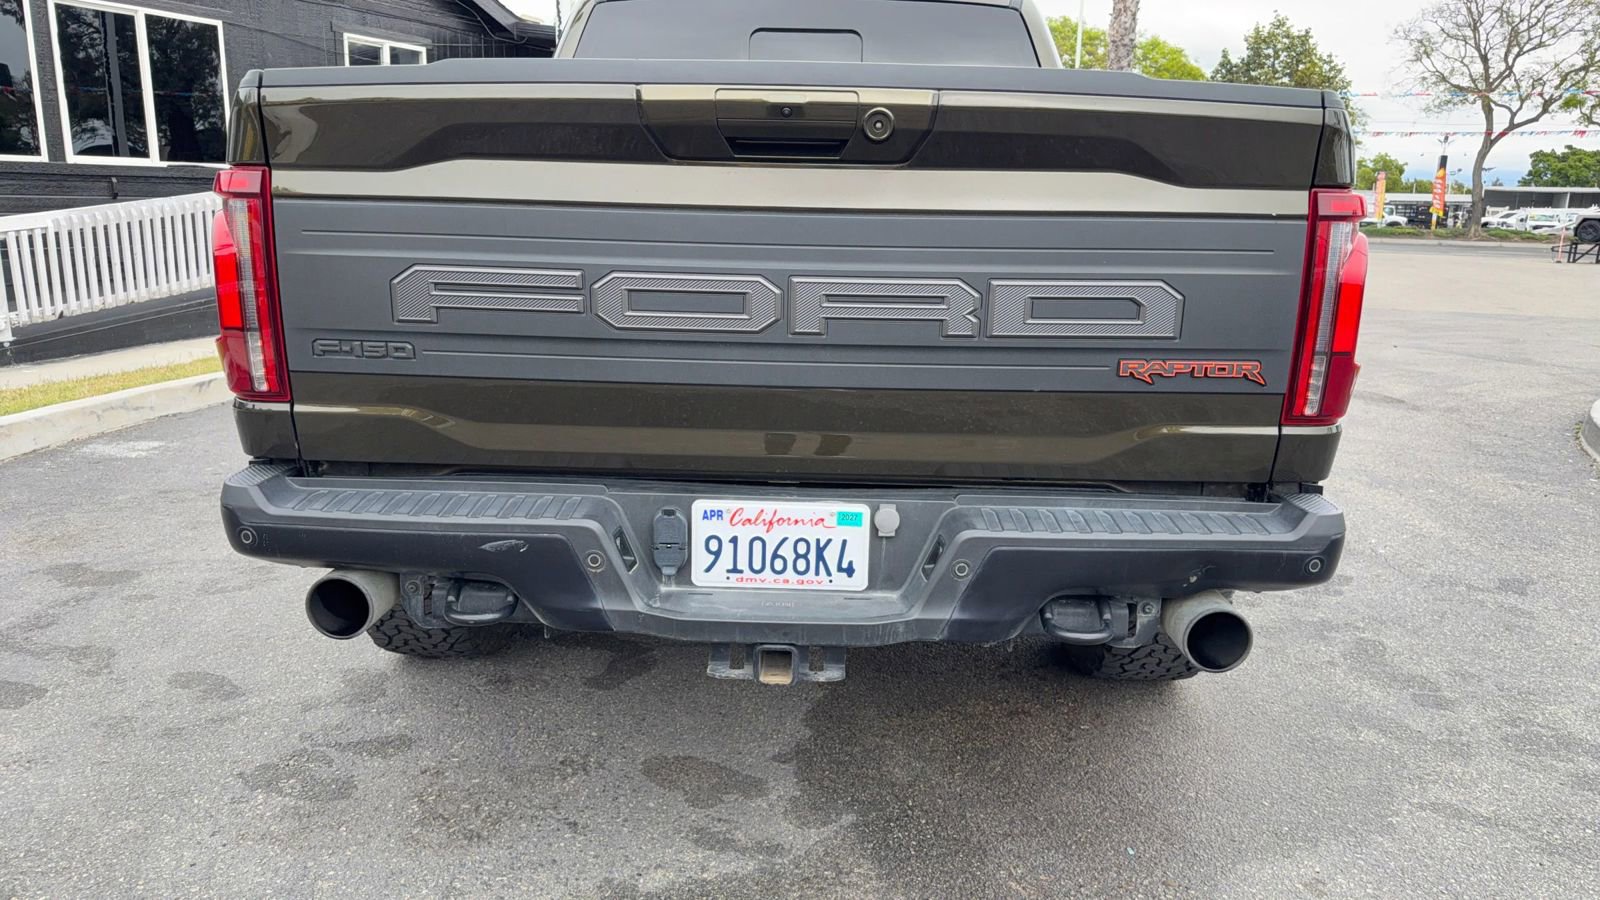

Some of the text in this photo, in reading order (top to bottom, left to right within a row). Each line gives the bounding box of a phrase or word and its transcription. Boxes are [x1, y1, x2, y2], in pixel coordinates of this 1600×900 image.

[391, 262, 1185, 340] FORD
[312, 338, 416, 360] F-150
[1118, 359, 1266, 386] RAPTOR
[702, 509, 724, 521] APR
[729, 507, 836, 533] California
[841, 513, 858, 521] 2027
[703, 534, 856, 578] 91068K4
[736, 575, 823, 585] dmv.ca.gov
